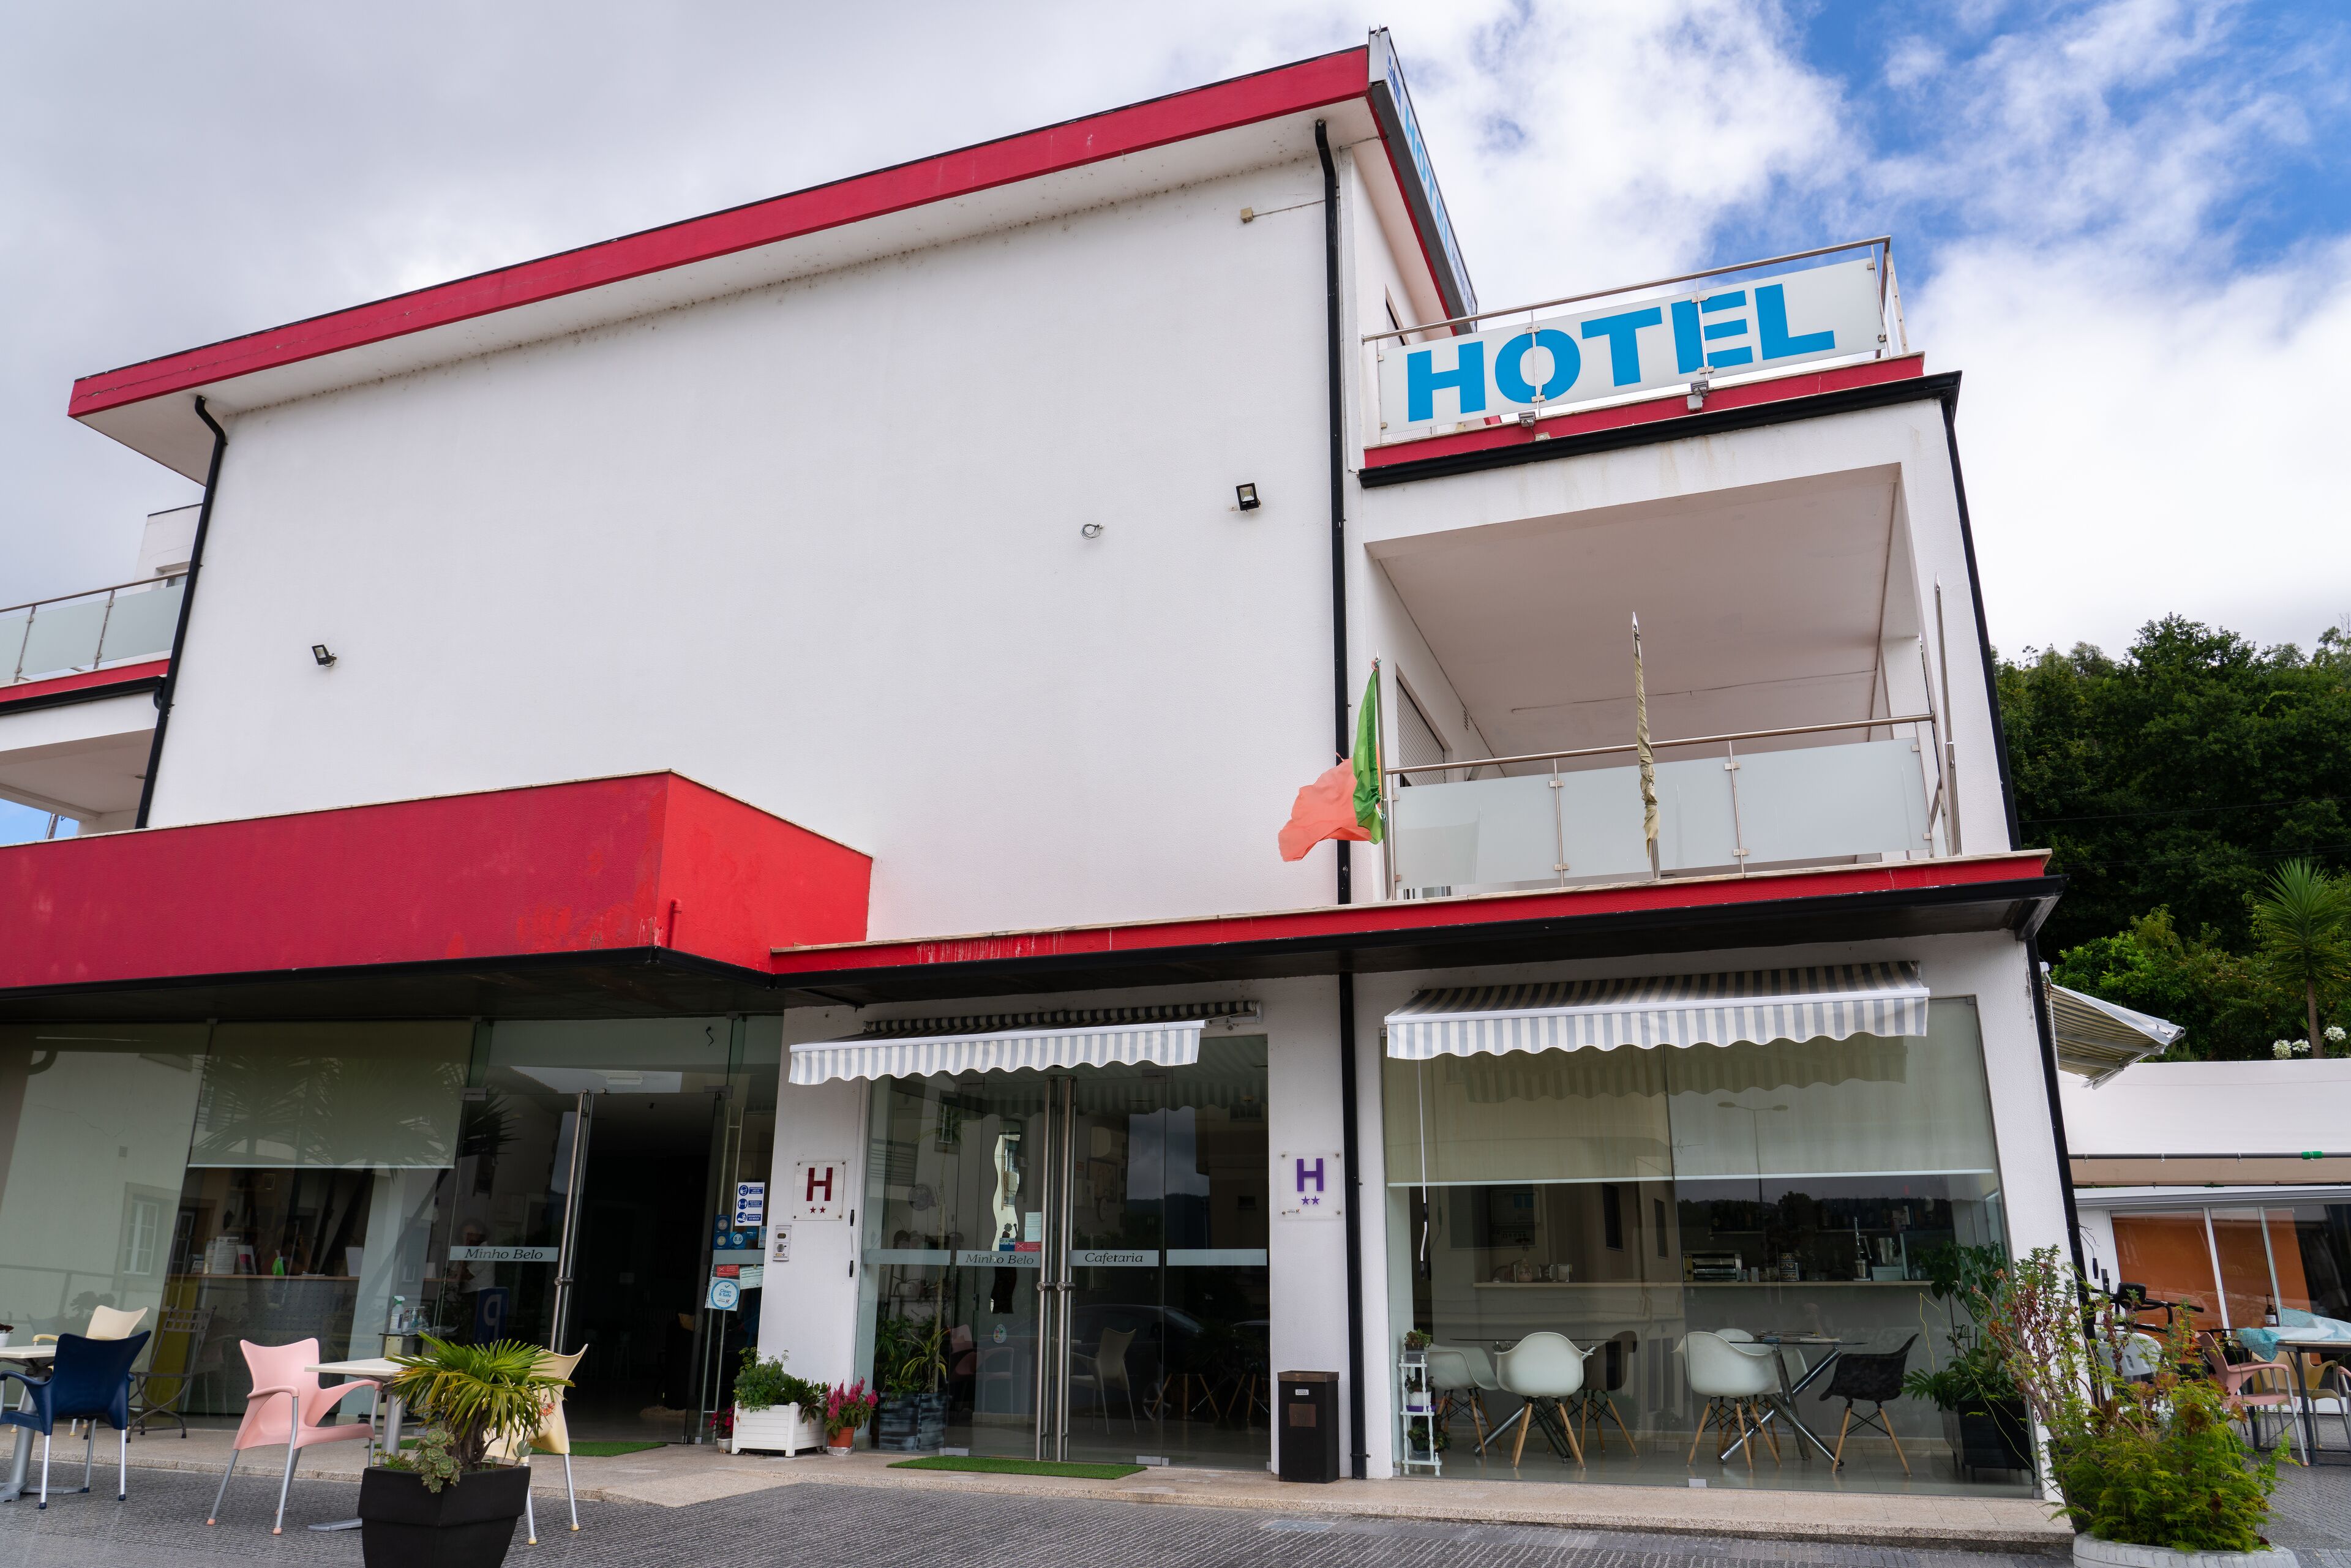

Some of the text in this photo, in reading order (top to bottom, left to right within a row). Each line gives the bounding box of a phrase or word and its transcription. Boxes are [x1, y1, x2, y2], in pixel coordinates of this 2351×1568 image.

[1406, 105, 1452, 261] HOTEL
[1408, 283, 1835, 422] HOTEL
[806, 1167, 833, 1201] H
[1296, 1158, 1324, 1191] H
[465, 1248, 543, 1259] Minho Belo
[965, 1254, 1034, 1265] Minho Belo
[1085, 1252, 1143, 1264] Cafetaria
